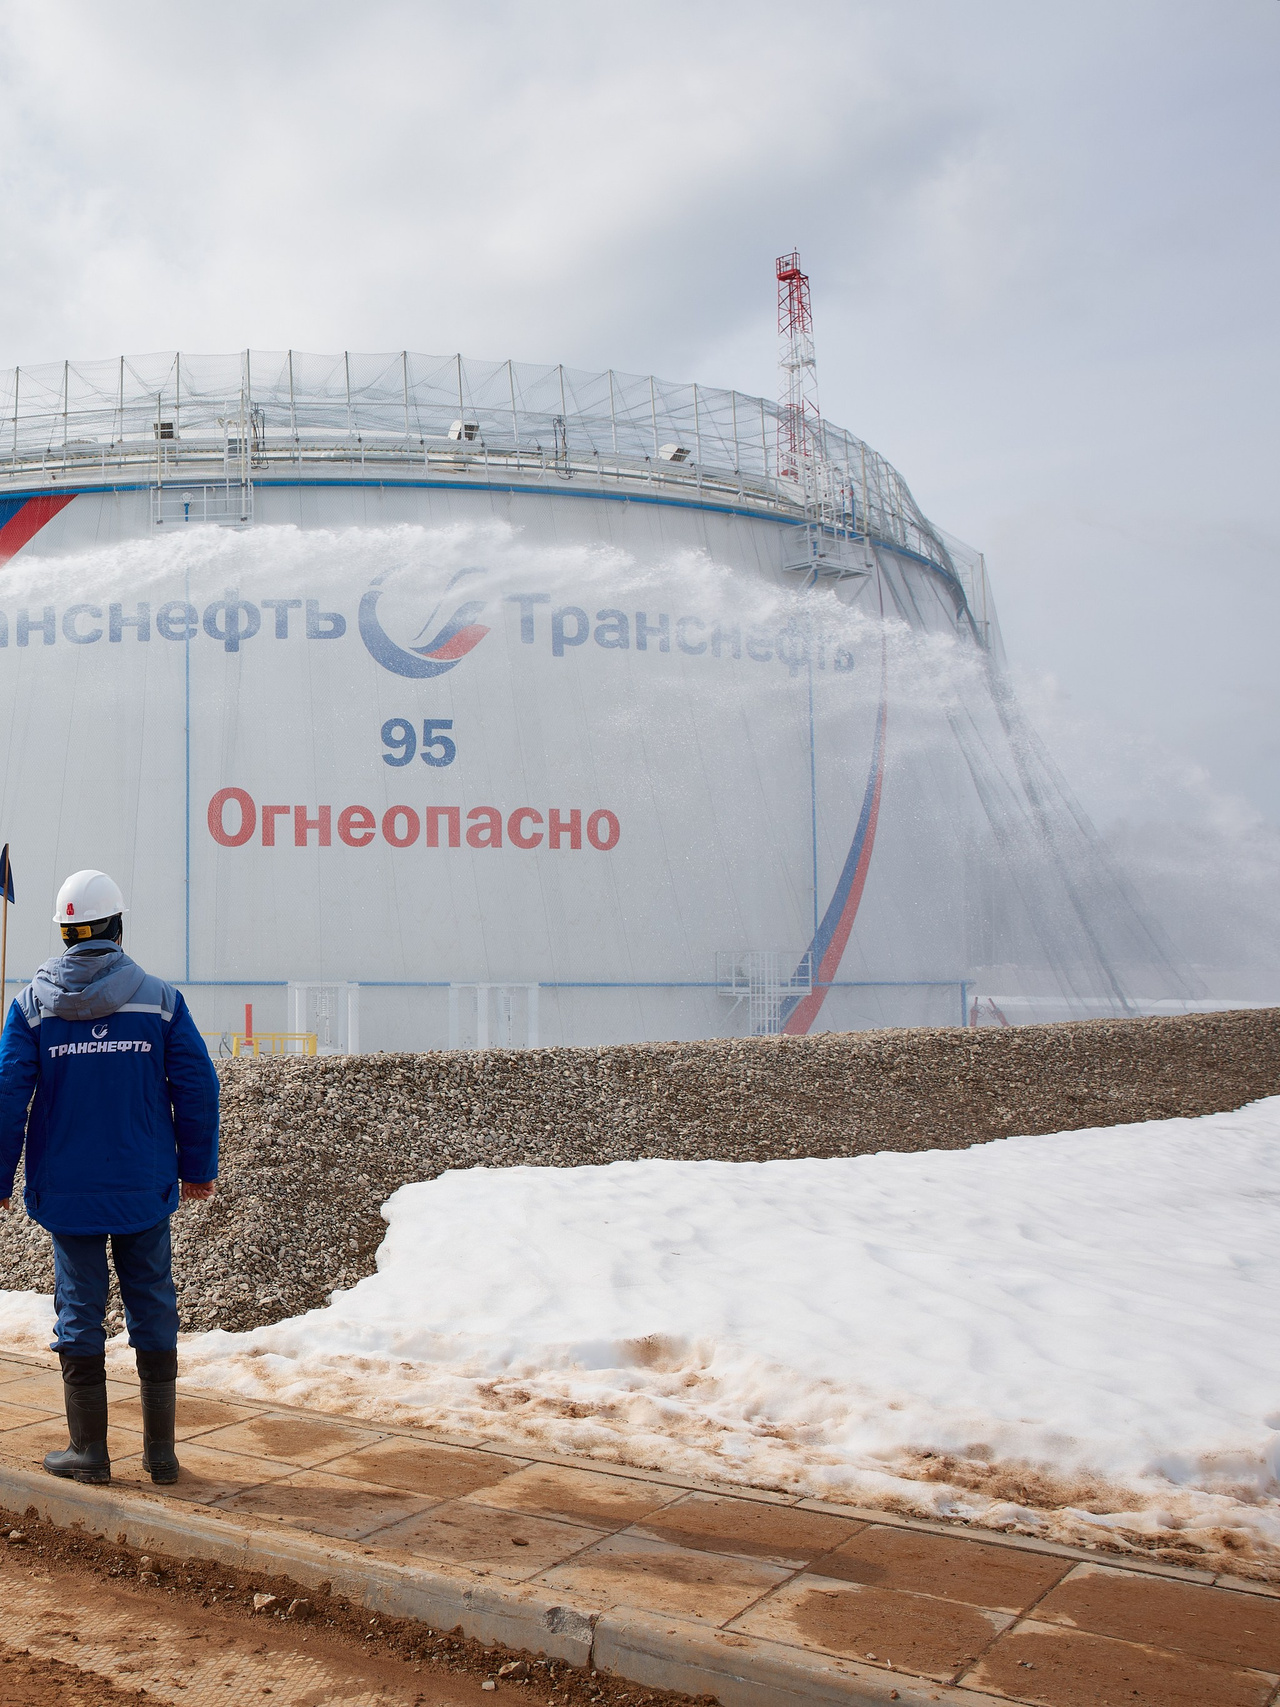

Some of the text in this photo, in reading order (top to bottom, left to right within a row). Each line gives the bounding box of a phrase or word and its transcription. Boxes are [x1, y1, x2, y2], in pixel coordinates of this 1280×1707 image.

[380, 717, 457, 767] 95
[207, 787, 621, 851] Огнеопасно
[48, 1041, 152, 1058] ТРАНСНЕФТЬ
